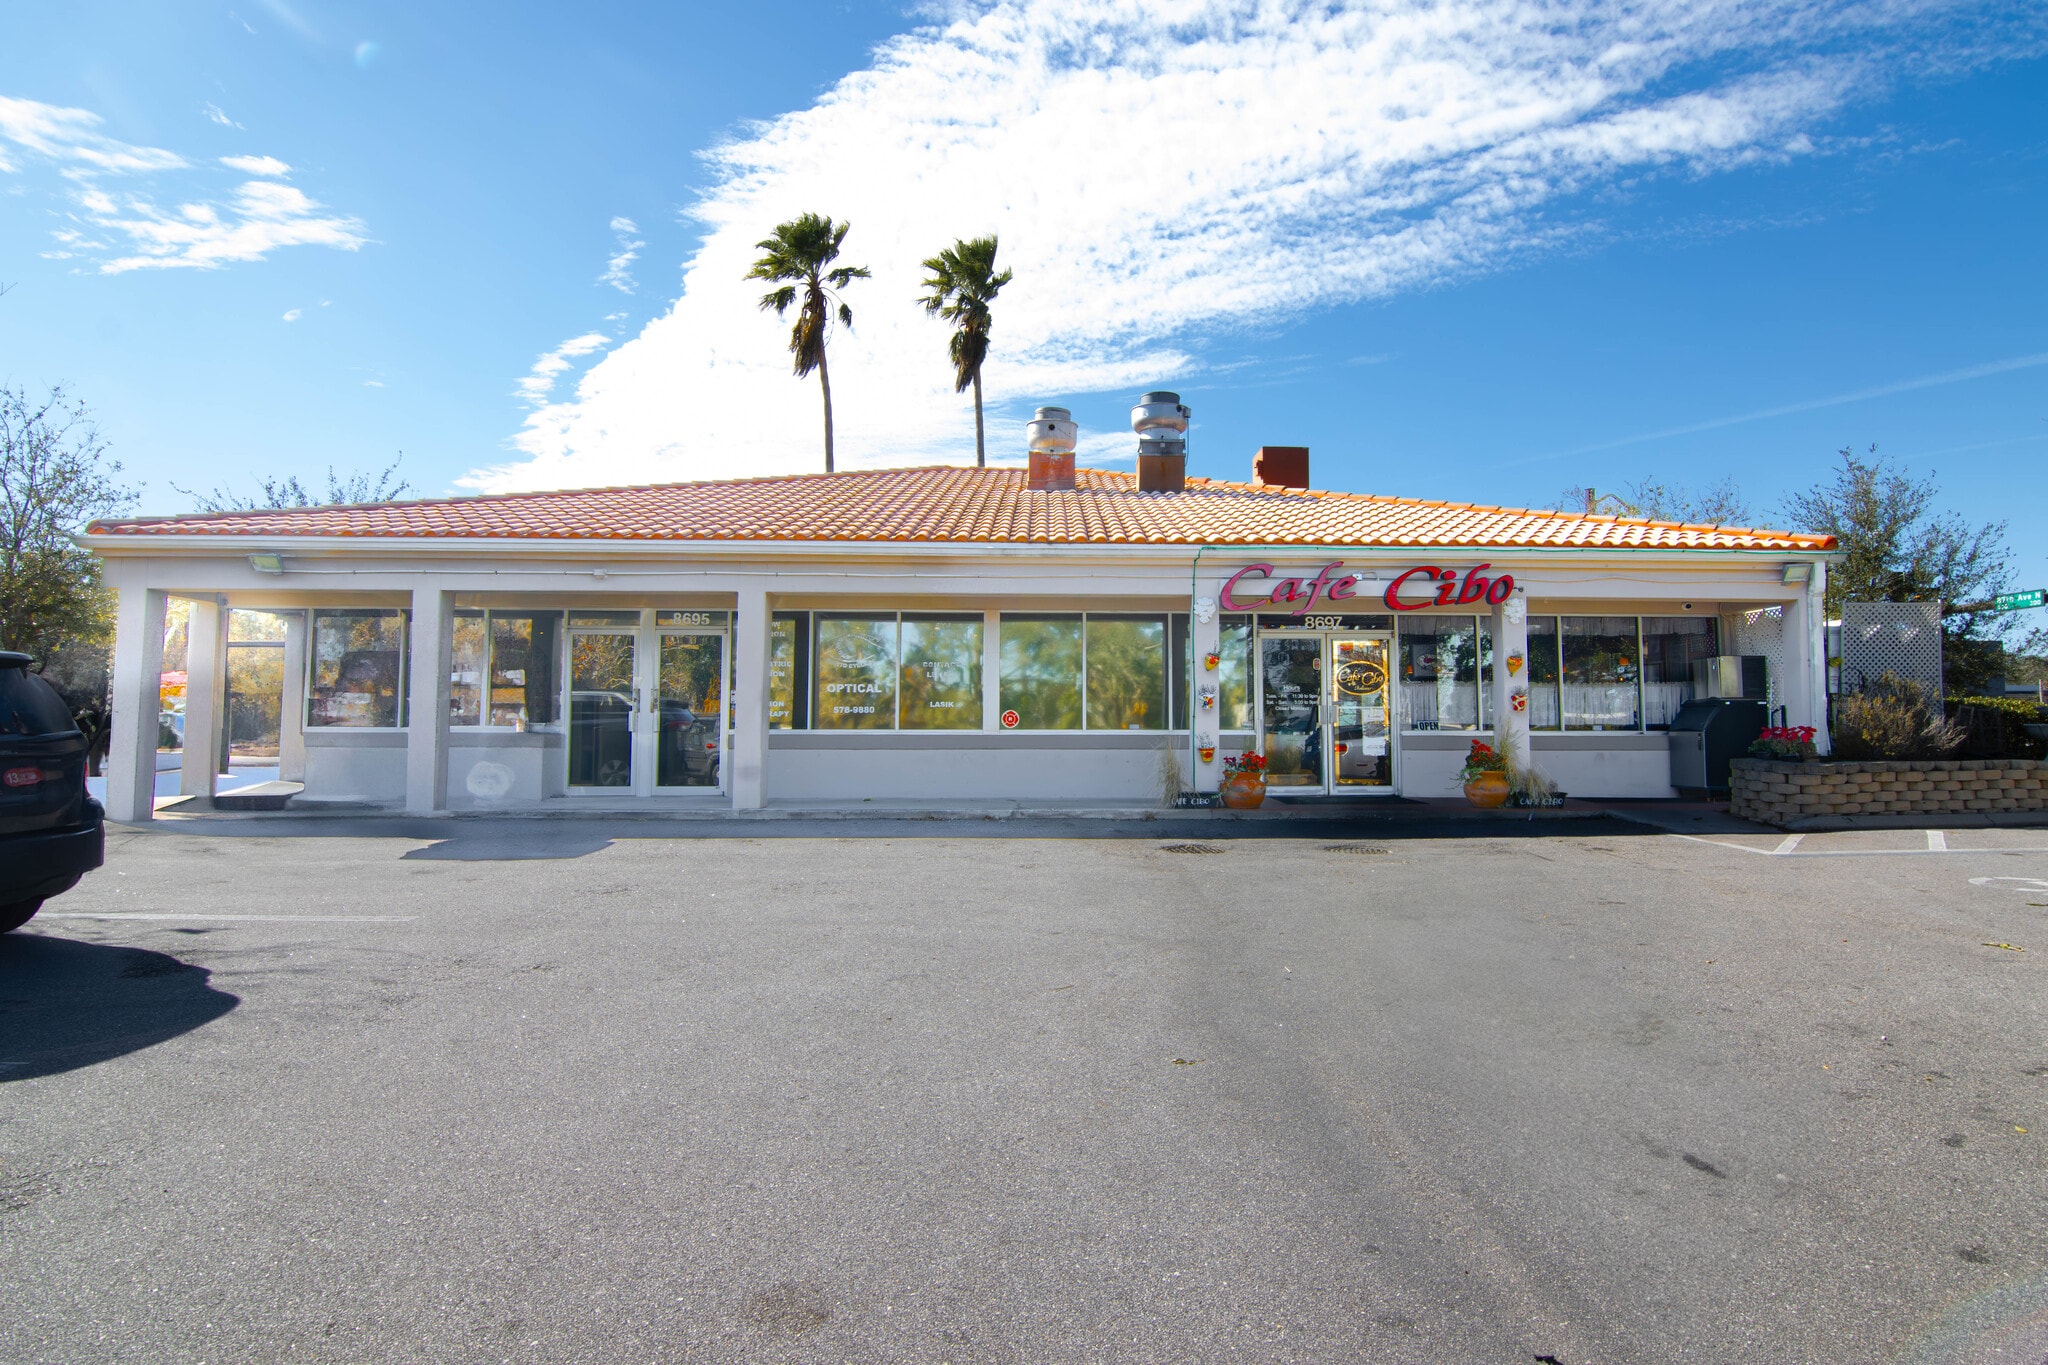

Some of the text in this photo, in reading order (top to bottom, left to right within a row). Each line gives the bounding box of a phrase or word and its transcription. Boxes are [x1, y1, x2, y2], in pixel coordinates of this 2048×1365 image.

[1220, 561, 1514, 617] Cafe Cibo
[2035, 591, 2041, 599] N
[673, 612, 710, 625] 8695
[1305, 616, 1343, 629] 8697
[1361, 671, 1384, 686] Cibo
[826, 683, 882, 693] OPTICAL
[1419, 722, 1439, 731] OPEN
[1191, 797, 1210, 805] CIBO
[1542, 798, 1563, 806] CIBO
